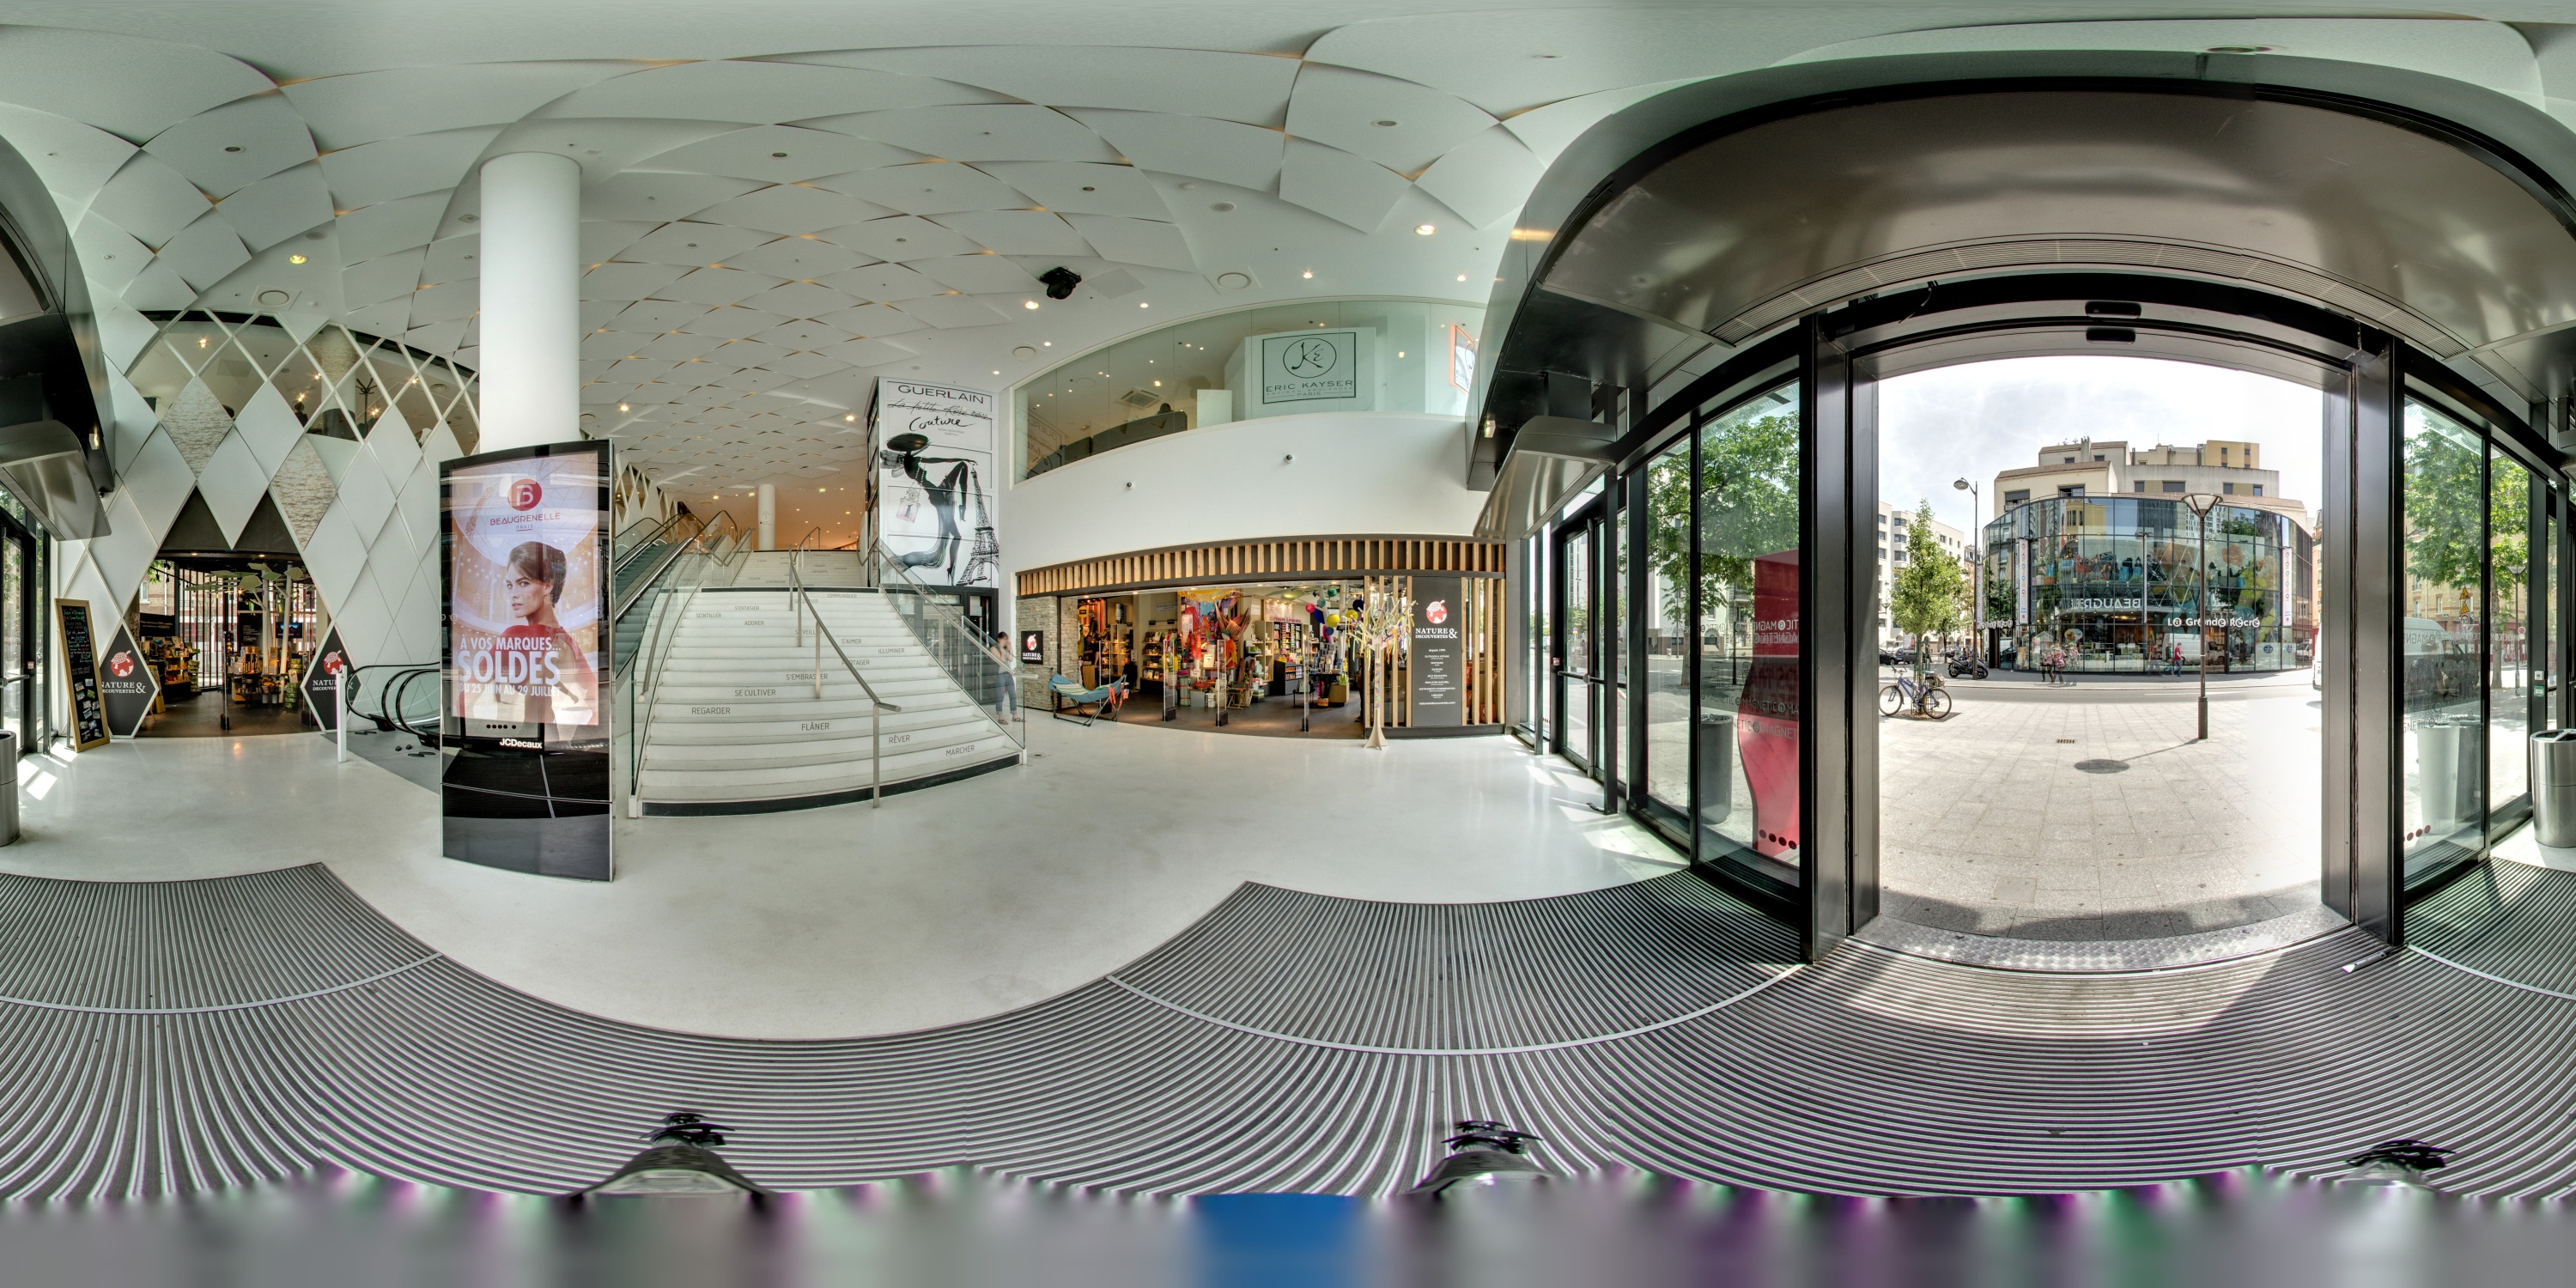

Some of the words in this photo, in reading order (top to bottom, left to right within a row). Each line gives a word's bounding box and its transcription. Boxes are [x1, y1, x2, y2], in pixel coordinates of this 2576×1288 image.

[1266, 383, 1296, 392] ERIC
[1302, 380, 1353, 389] KAYSER
[897, 385, 984, 404] GUERLAIN
[908, 416, 976, 432] Couture
[489, 512, 561, 526] BEAUGRENELLE
[2167, 617, 2182, 628] La
[2229, 616, 2261, 628] Récré
[1448, 628, 1458, 639] &
[459, 634, 468, 650] À
[471, 636, 493, 651] VOS
[495, 636, 562, 651] MARQUES...
[457, 650, 561, 685] SOLDES
[135, 682, 146, 694] &
[459, 683, 470, 694] DU
[471, 683, 482, 695] 25
[483, 683, 501, 695] JUIN
[503, 683, 515, 696] AU
[517, 684, 528, 696] 29
[531, 684, 561, 697] JUILLET
[801, 722, 830, 731] FLÂNER
[499, 738, 543, 749] JCDecaux
[888, 734, 910, 744] RÊVER
[945, 744, 975, 756] MARCHER
